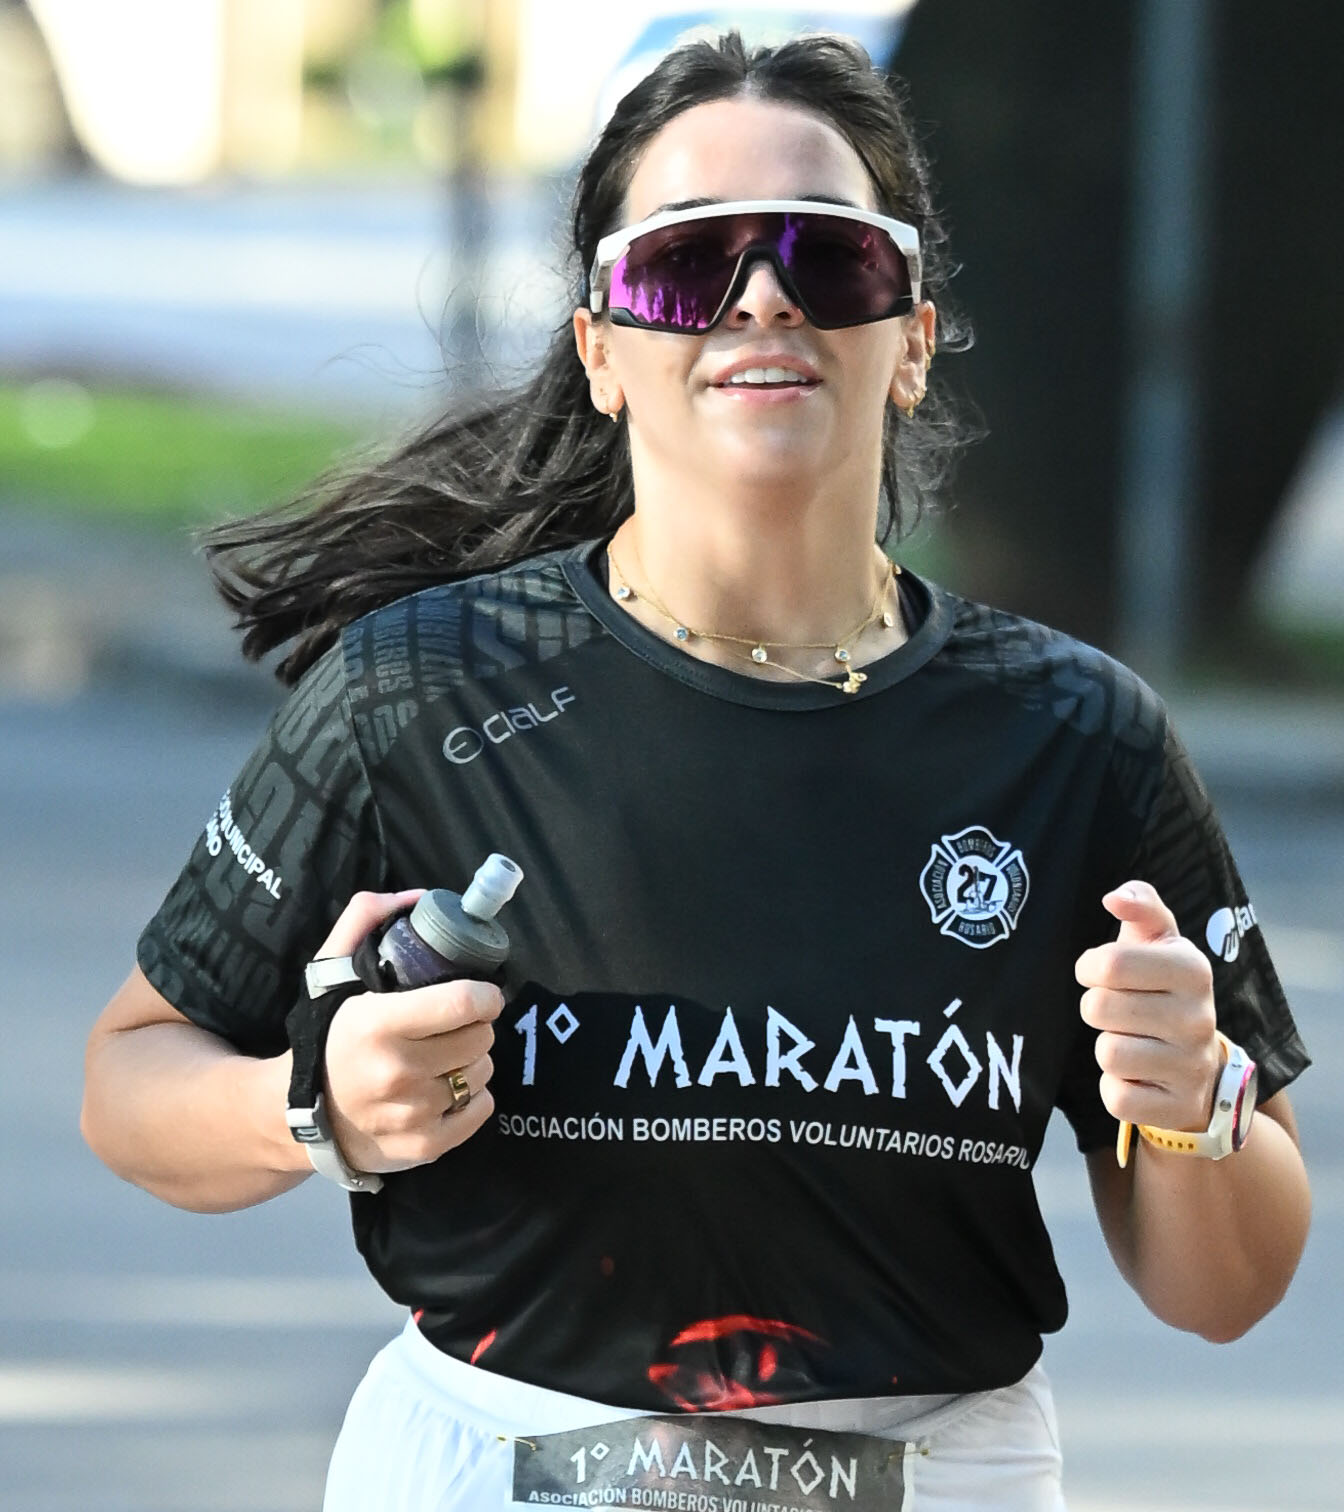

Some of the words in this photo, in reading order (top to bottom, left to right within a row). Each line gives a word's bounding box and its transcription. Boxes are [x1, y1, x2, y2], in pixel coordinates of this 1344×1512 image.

[957, 863, 998, 903] 27
[613, 998, 1024, 1114] MARATÓN
[498, 1111, 624, 1141] SOCIACIÓN
[632, 1117, 782, 1143] BOMBEROS
[789, 1119, 955, 1160] VOLUNTARIOS
[627, 1438, 857, 1501] MARATÓN
[529, 1484, 627, 1506] ASOCIACIÓN
